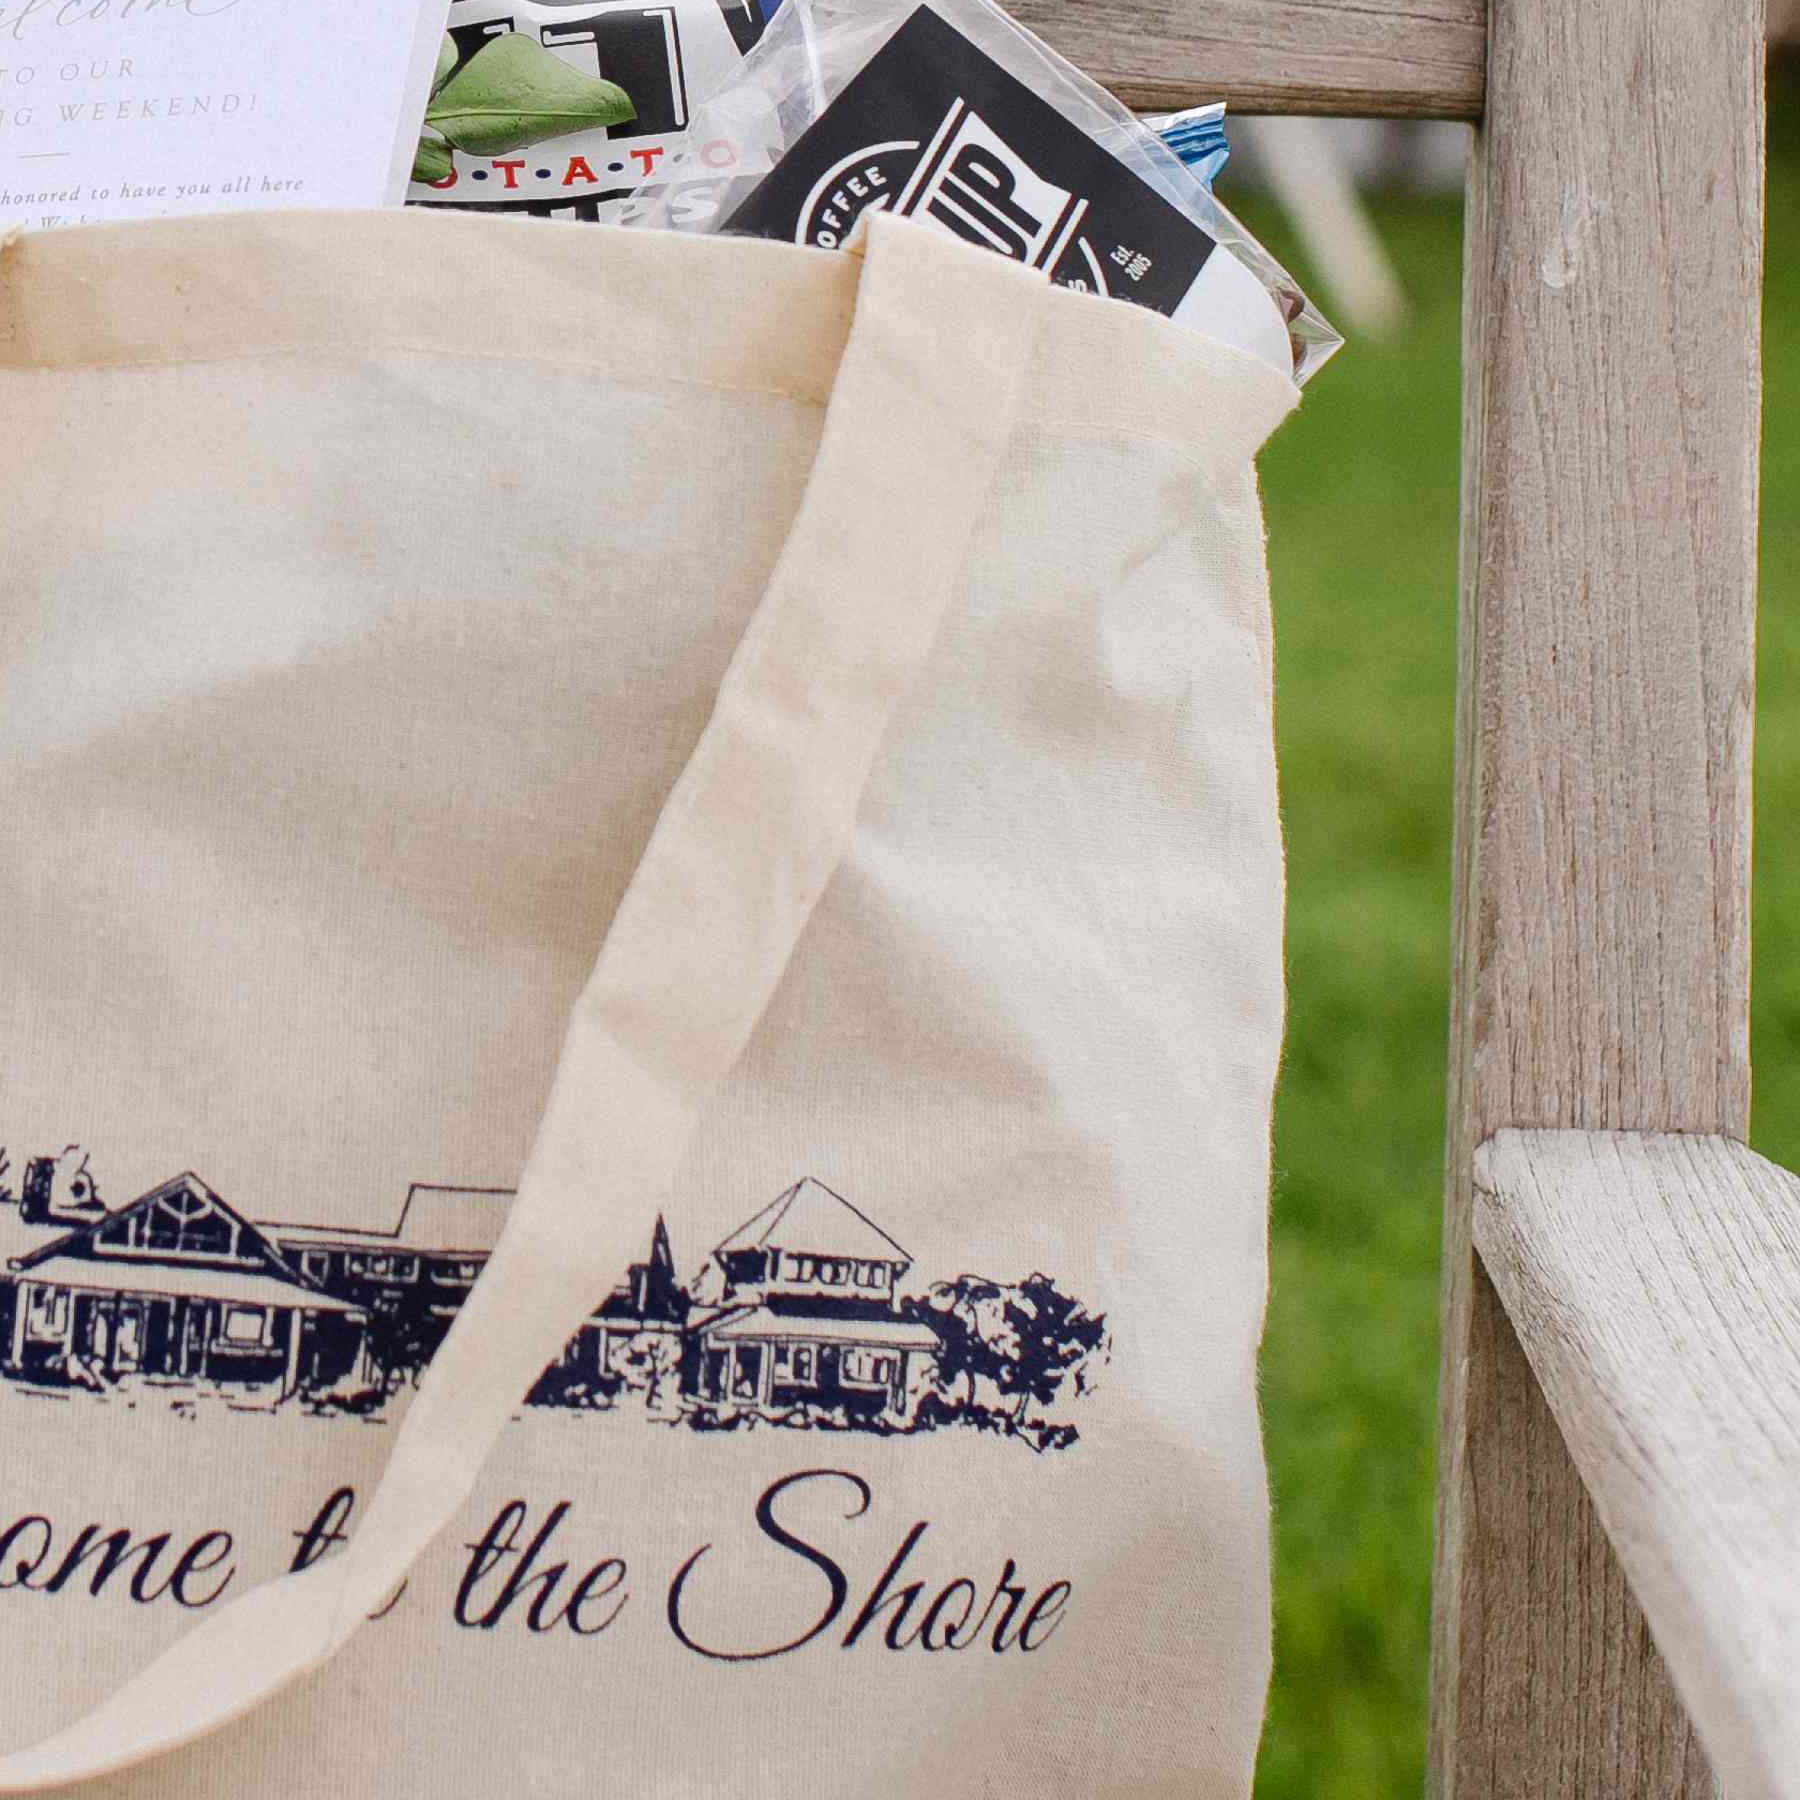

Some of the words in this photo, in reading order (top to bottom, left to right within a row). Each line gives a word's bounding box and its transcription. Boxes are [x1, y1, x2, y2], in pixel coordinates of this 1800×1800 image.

[59, 58, 136, 82] OUR
[59, 93, 257, 123] WEEKEND!
[1, 185, 81, 206] honored
[91, 187, 109, 200] to
[120, 182, 167, 199] have
[176, 184, 211, 199] you
[222, 176, 252, 193] all
[261, 175, 304, 192] here
[817, 166, 888, 249] OFFEE
[1125, 256, 1151, 282] 2005
[293, 1486, 408, 1620] t
[453, 1499, 628, 1635] the
[667, 1469, 1072, 1661] Shore
